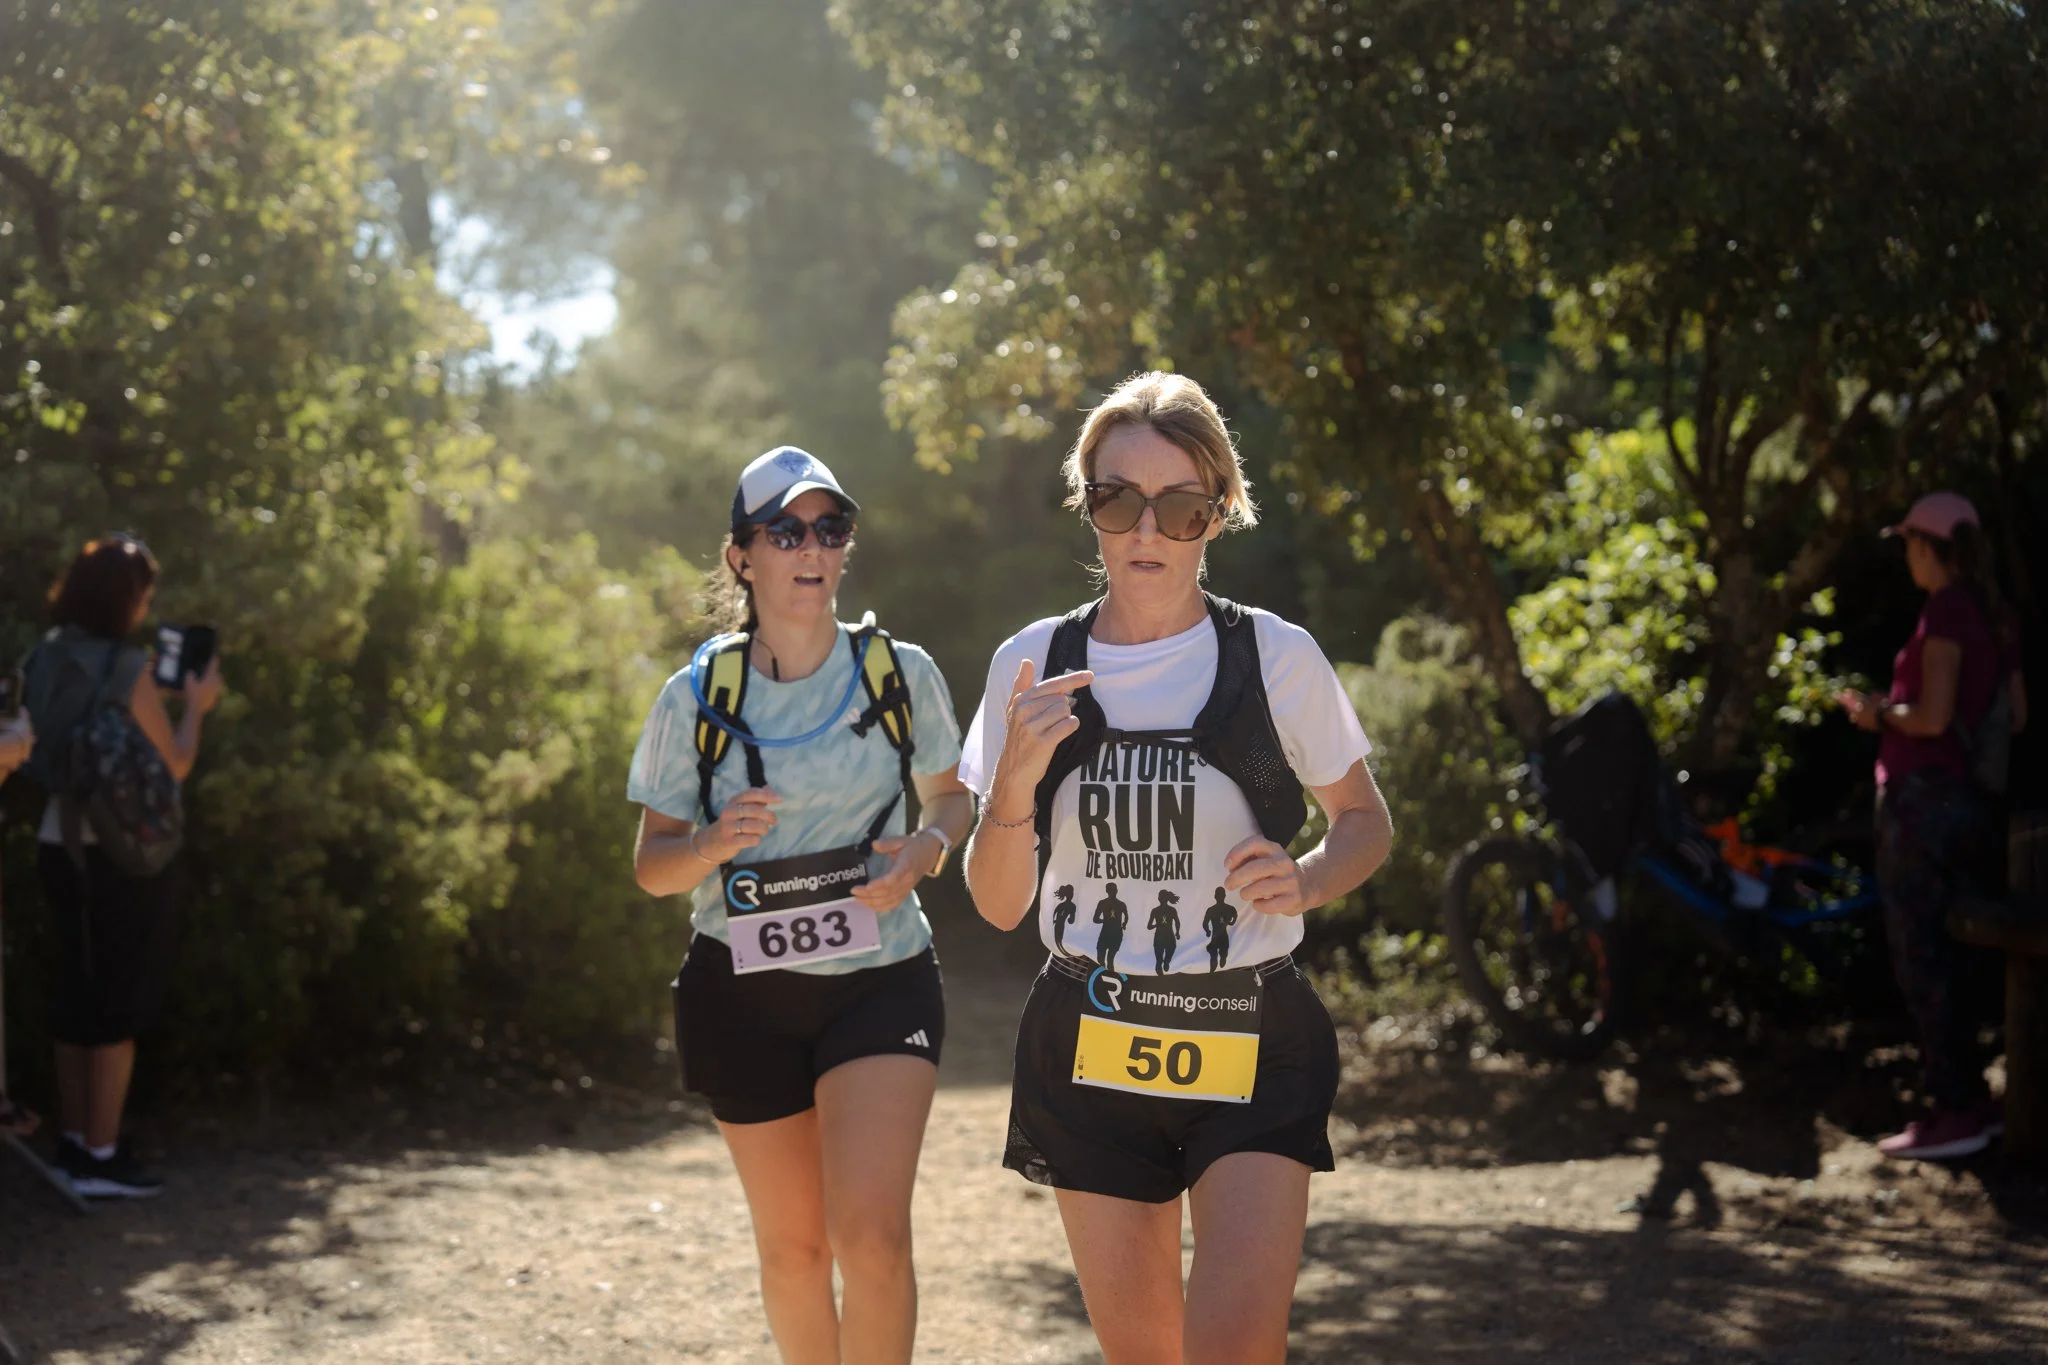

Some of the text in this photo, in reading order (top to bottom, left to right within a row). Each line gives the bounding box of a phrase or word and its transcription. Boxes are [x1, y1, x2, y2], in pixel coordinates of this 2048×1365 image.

[1080, 743, 1196, 783] NATURE
[1079, 784, 1195, 853] RUN
[1086, 850, 1193, 882] DE BOURBAKI
[758, 910, 852, 957] 683
[1126, 1035, 1203, 1086] 50
